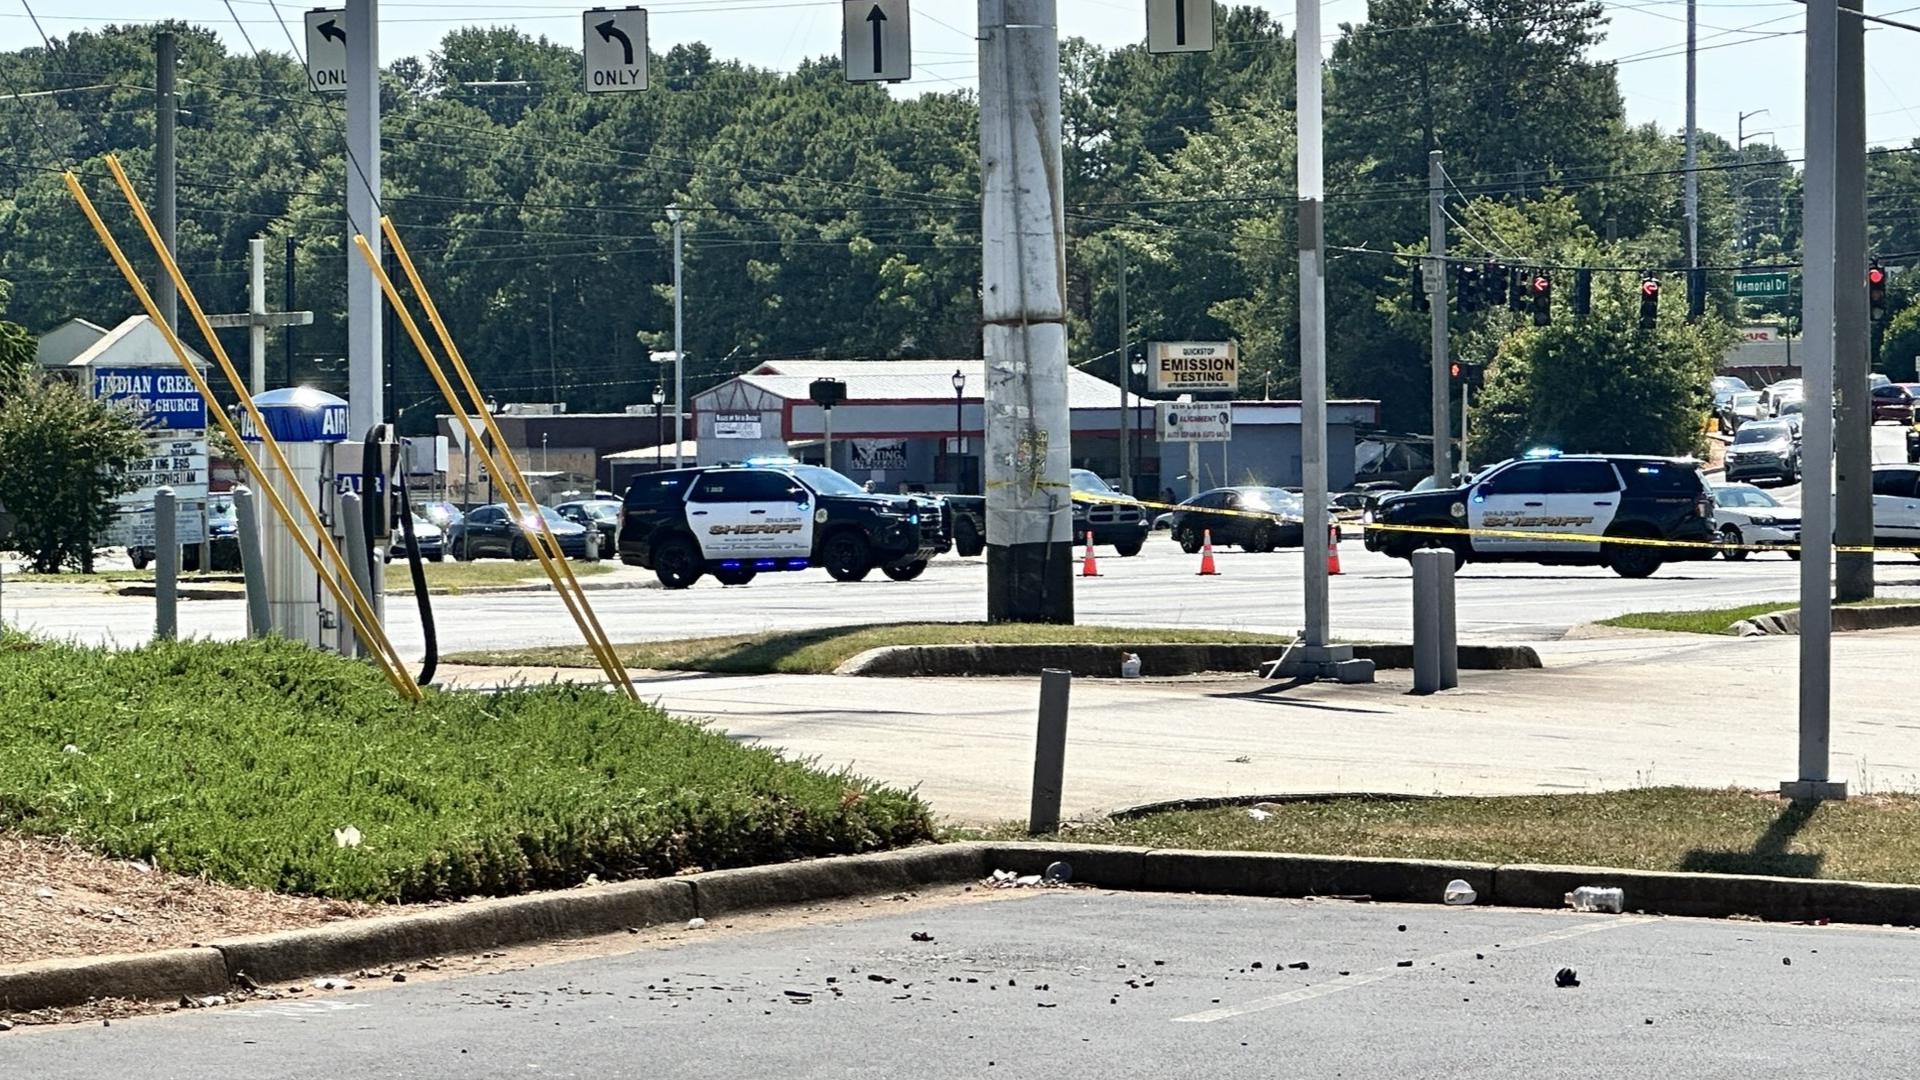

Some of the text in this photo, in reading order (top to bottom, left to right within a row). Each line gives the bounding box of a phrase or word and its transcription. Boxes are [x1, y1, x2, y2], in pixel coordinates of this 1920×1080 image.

[317, 69, 346, 86] ONL
[594, 69, 640, 86] ONLY
[1736, 278, 1787, 292] Memorial Dr
[1161, 359, 1235, 371] EMISSION
[1173, 372, 1224, 382] TESTING
[100, 375, 203, 393] INDIAN CREE
[155, 399, 199, 412] CHURCH
[322, 408, 346, 435] AIR
[155, 458, 170, 470] KING
[172, 457, 190, 470] JESUS
[1482, 516, 1594, 527] SHERIFF
[709, 524, 803, 535] SHERIFF
